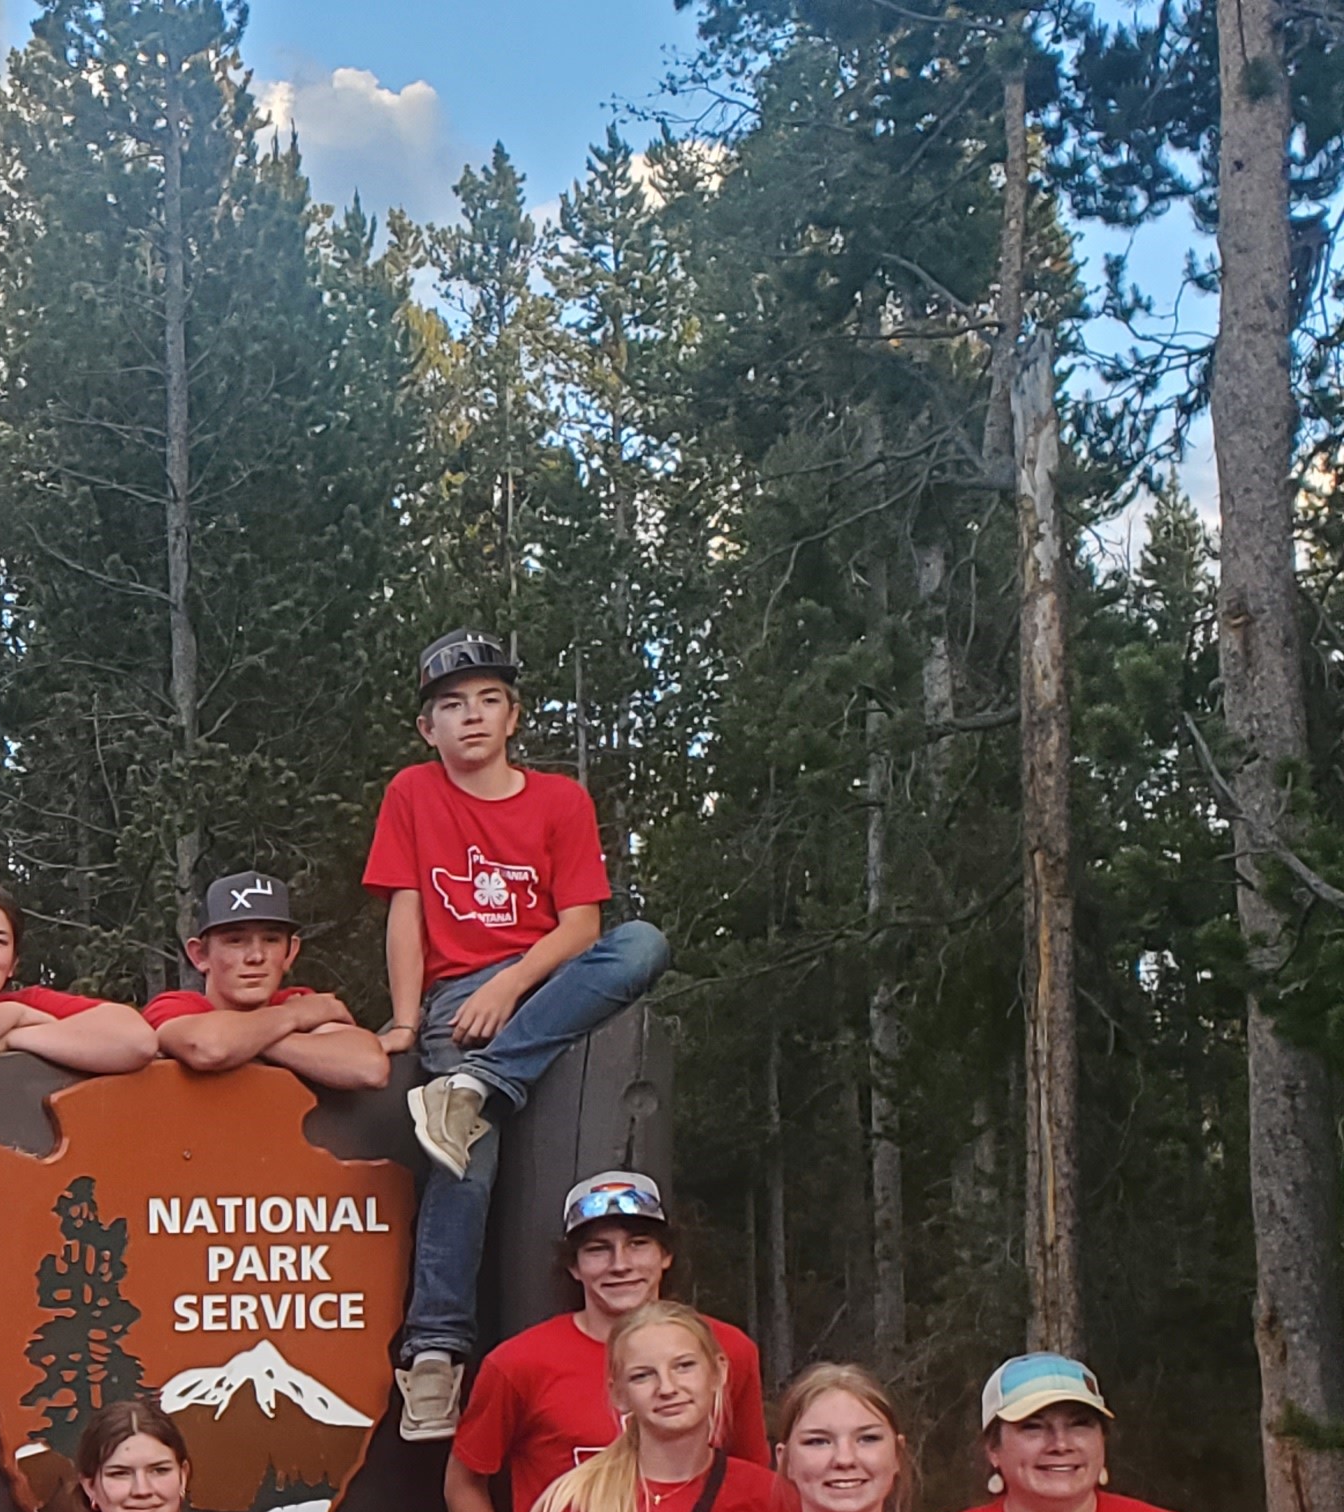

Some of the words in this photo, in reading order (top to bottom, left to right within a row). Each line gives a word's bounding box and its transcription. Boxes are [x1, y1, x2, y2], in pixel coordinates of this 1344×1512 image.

[148, 1196, 389, 1234] NATIONAL
[208, 1244, 331, 1282] PARK
[173, 1292, 366, 1331] SERVICE
